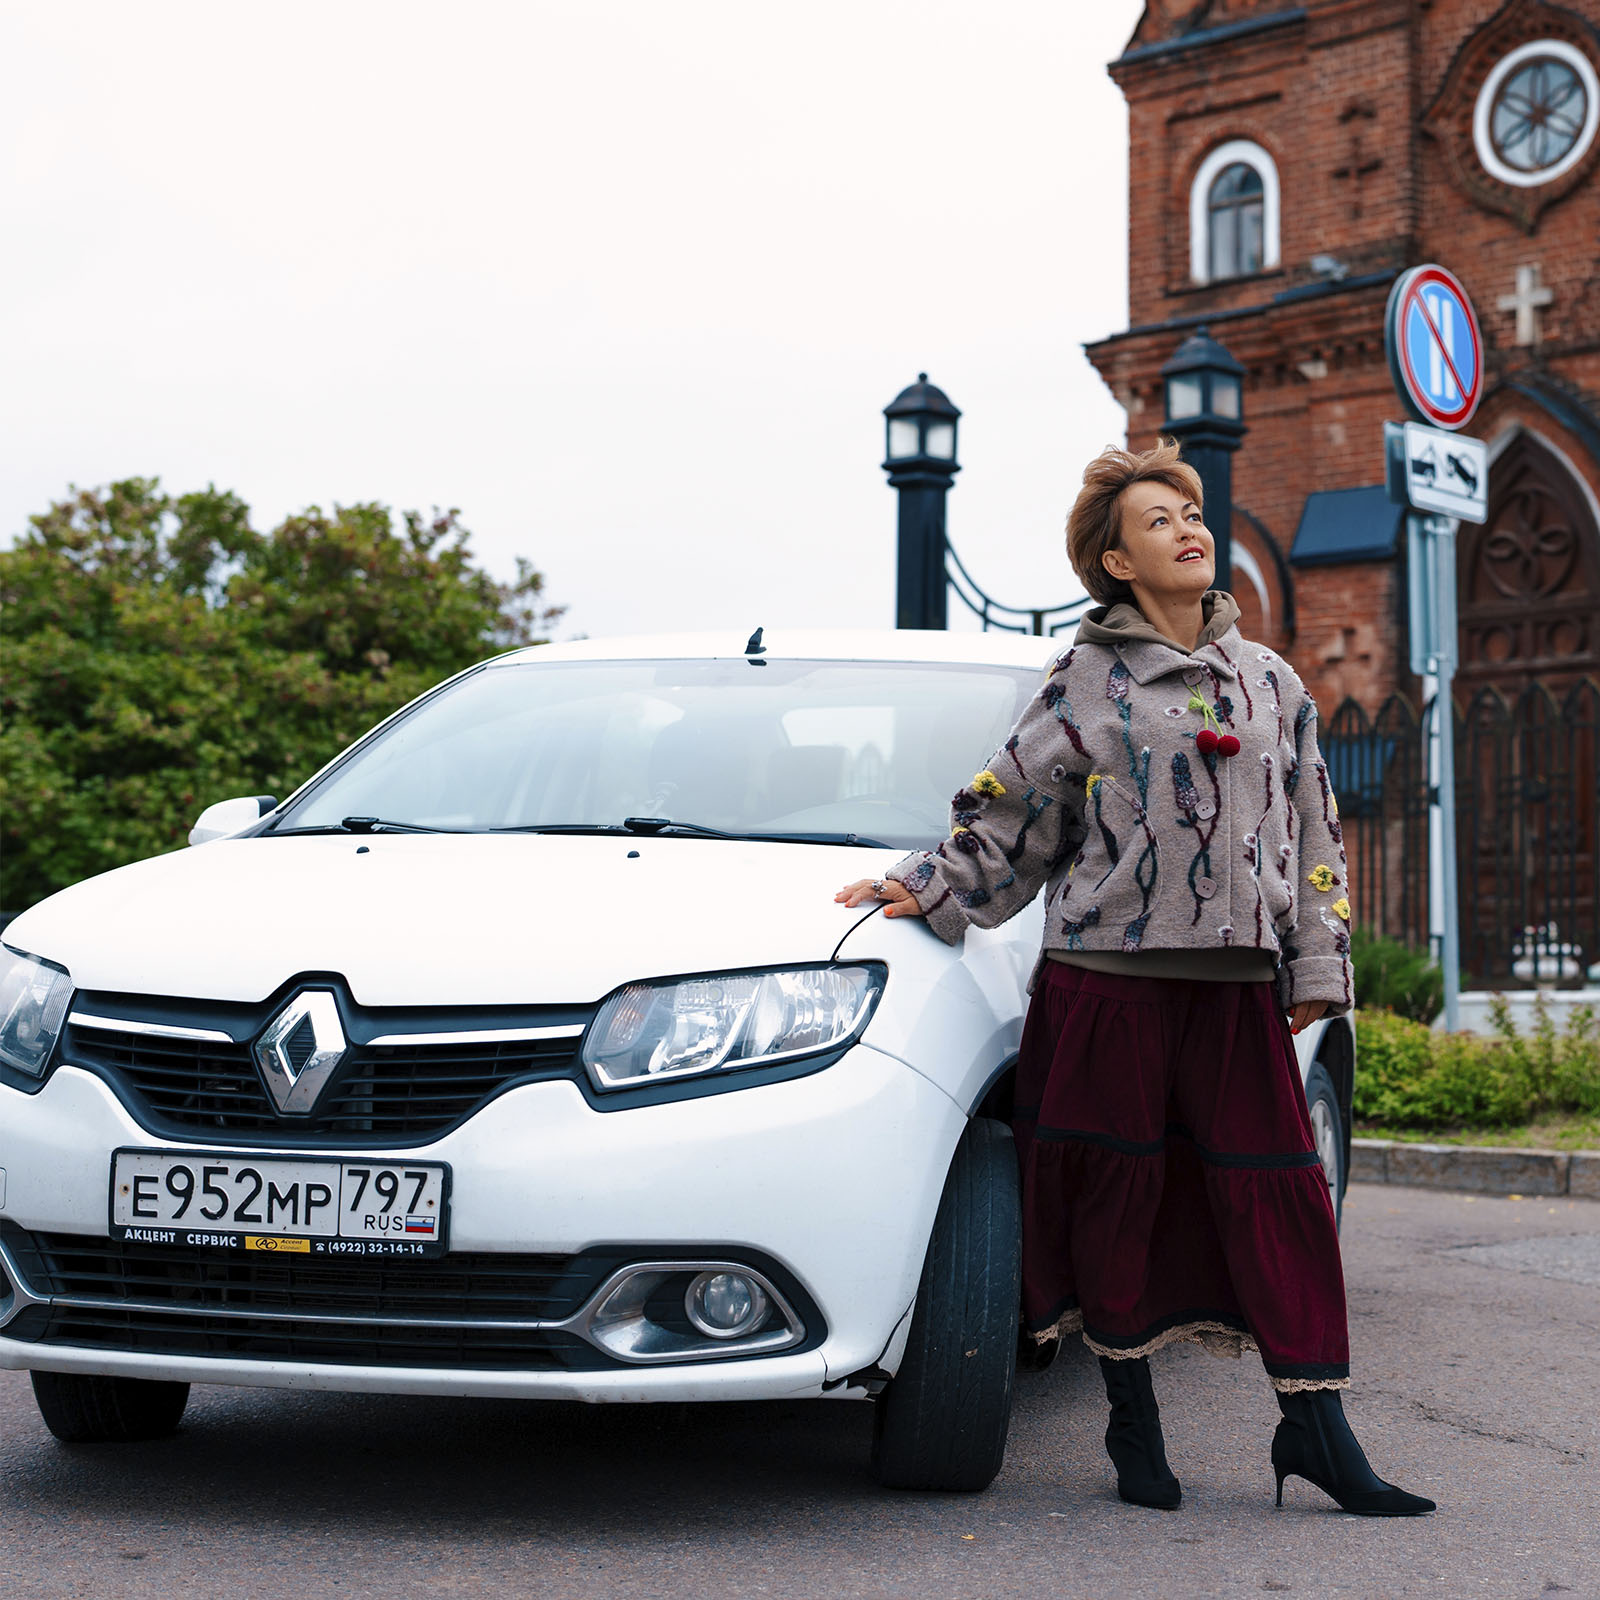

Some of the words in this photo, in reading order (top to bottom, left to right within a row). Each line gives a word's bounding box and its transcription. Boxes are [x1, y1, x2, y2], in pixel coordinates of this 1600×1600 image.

[347, 1169, 428, 1214] 797
[364, 1215, 403, 1231] RUS
[124, 1228, 176, 1243] АКЦЕНТ
[186, 1233, 238, 1247] СЕРВИС
[328, 1241, 366, 1255] (4922)
[368, 1243, 424, 1254] 32-14-14
